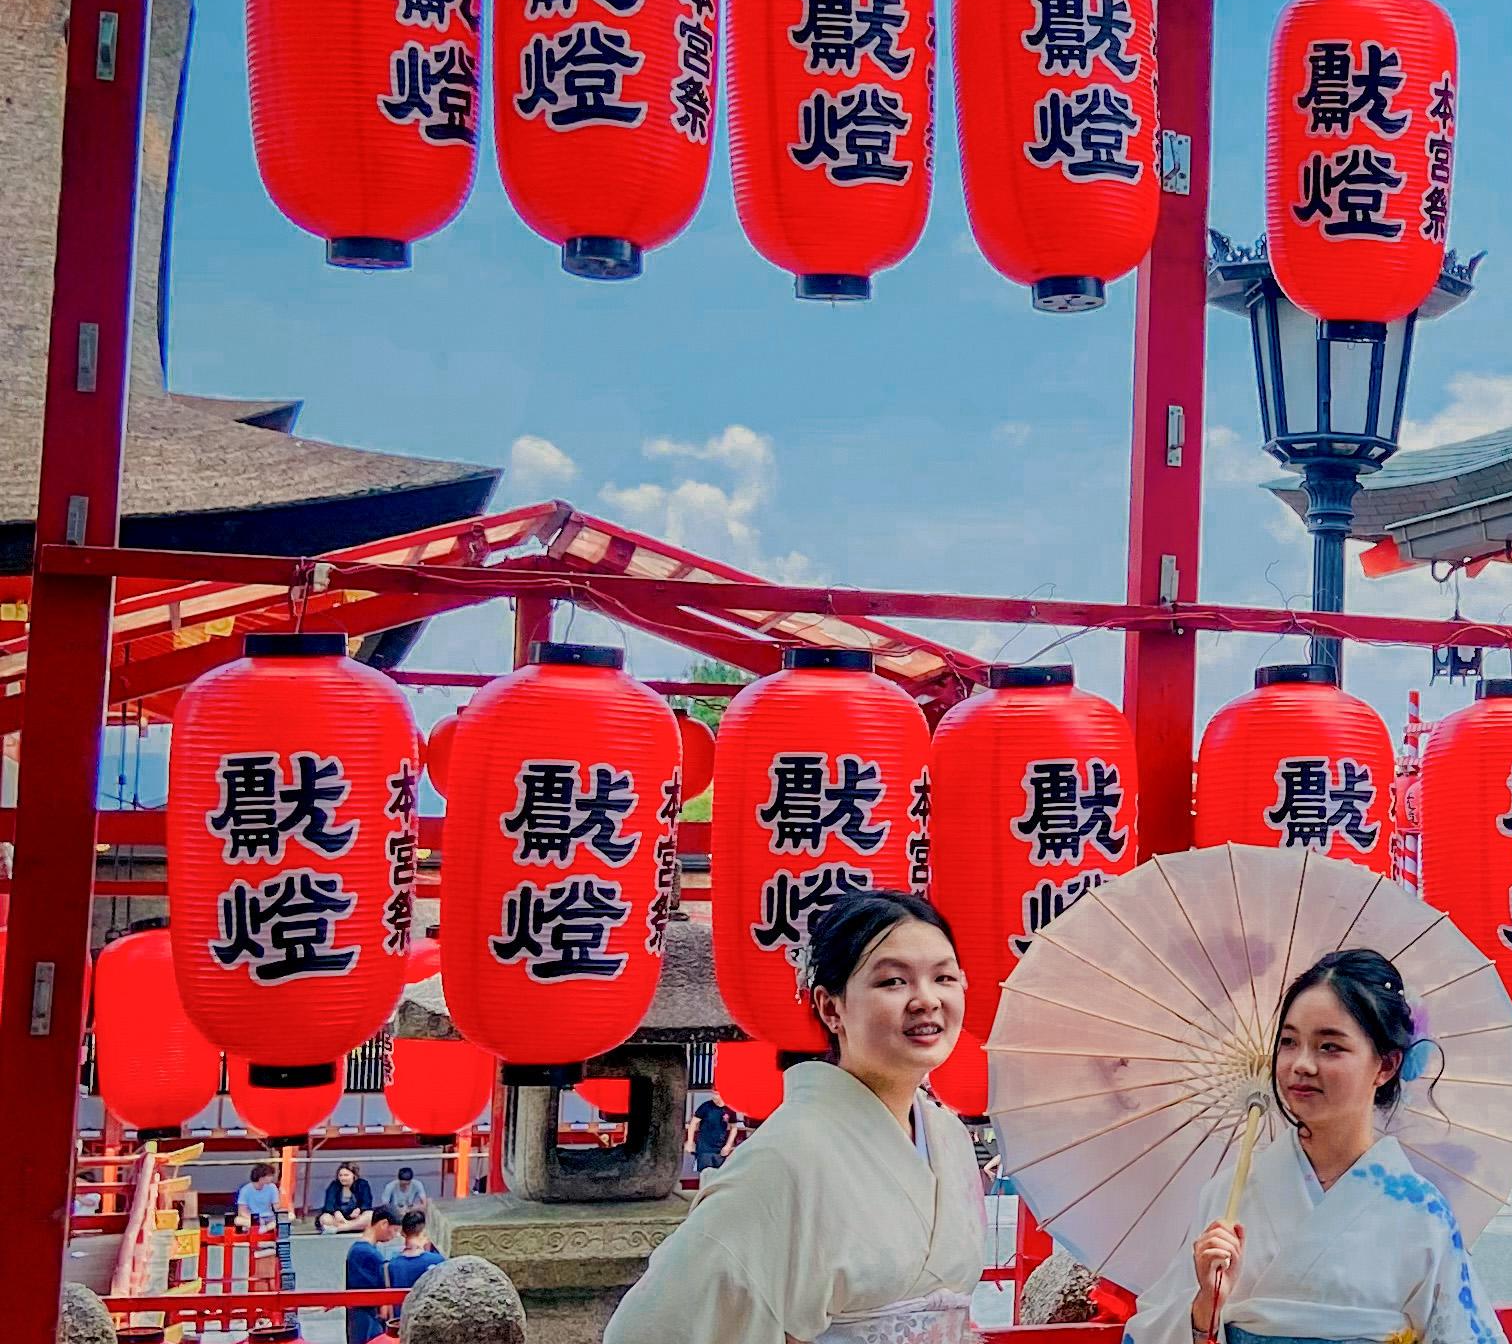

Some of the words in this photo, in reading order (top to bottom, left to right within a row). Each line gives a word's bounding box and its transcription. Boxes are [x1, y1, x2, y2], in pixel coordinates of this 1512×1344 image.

[1423, 76, 1455, 242] 本宮祭
[909, 771, 931, 900] 本宮
